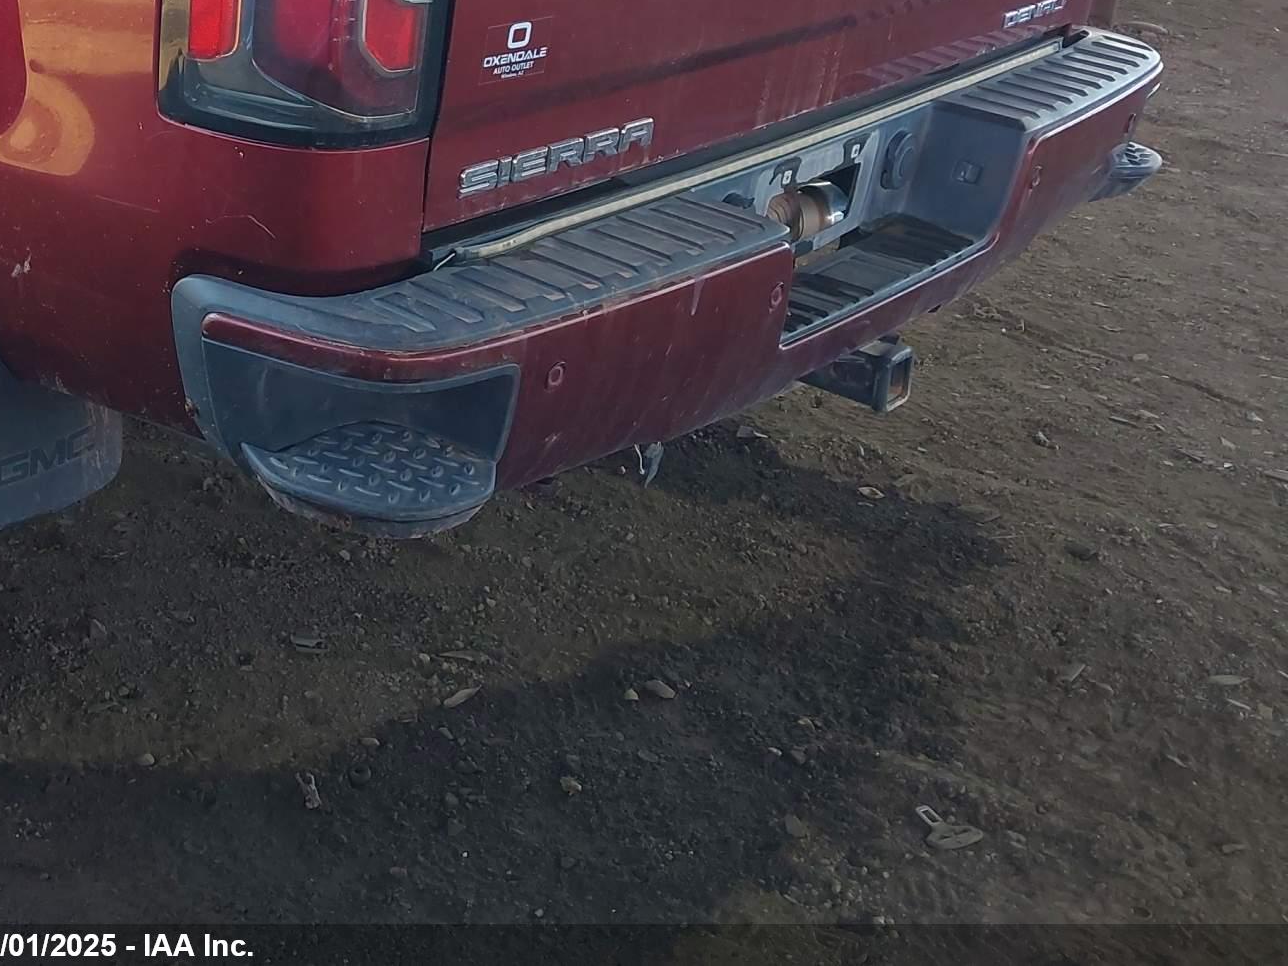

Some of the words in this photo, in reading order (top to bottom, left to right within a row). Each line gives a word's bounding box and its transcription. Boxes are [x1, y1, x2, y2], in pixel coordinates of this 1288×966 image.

[483, 47, 549, 68] OXENDALE
[492, 65, 511, 75] AUTO
[511, 60, 535, 73] OUTLET
[458, 116, 655, 198] SIERRA
